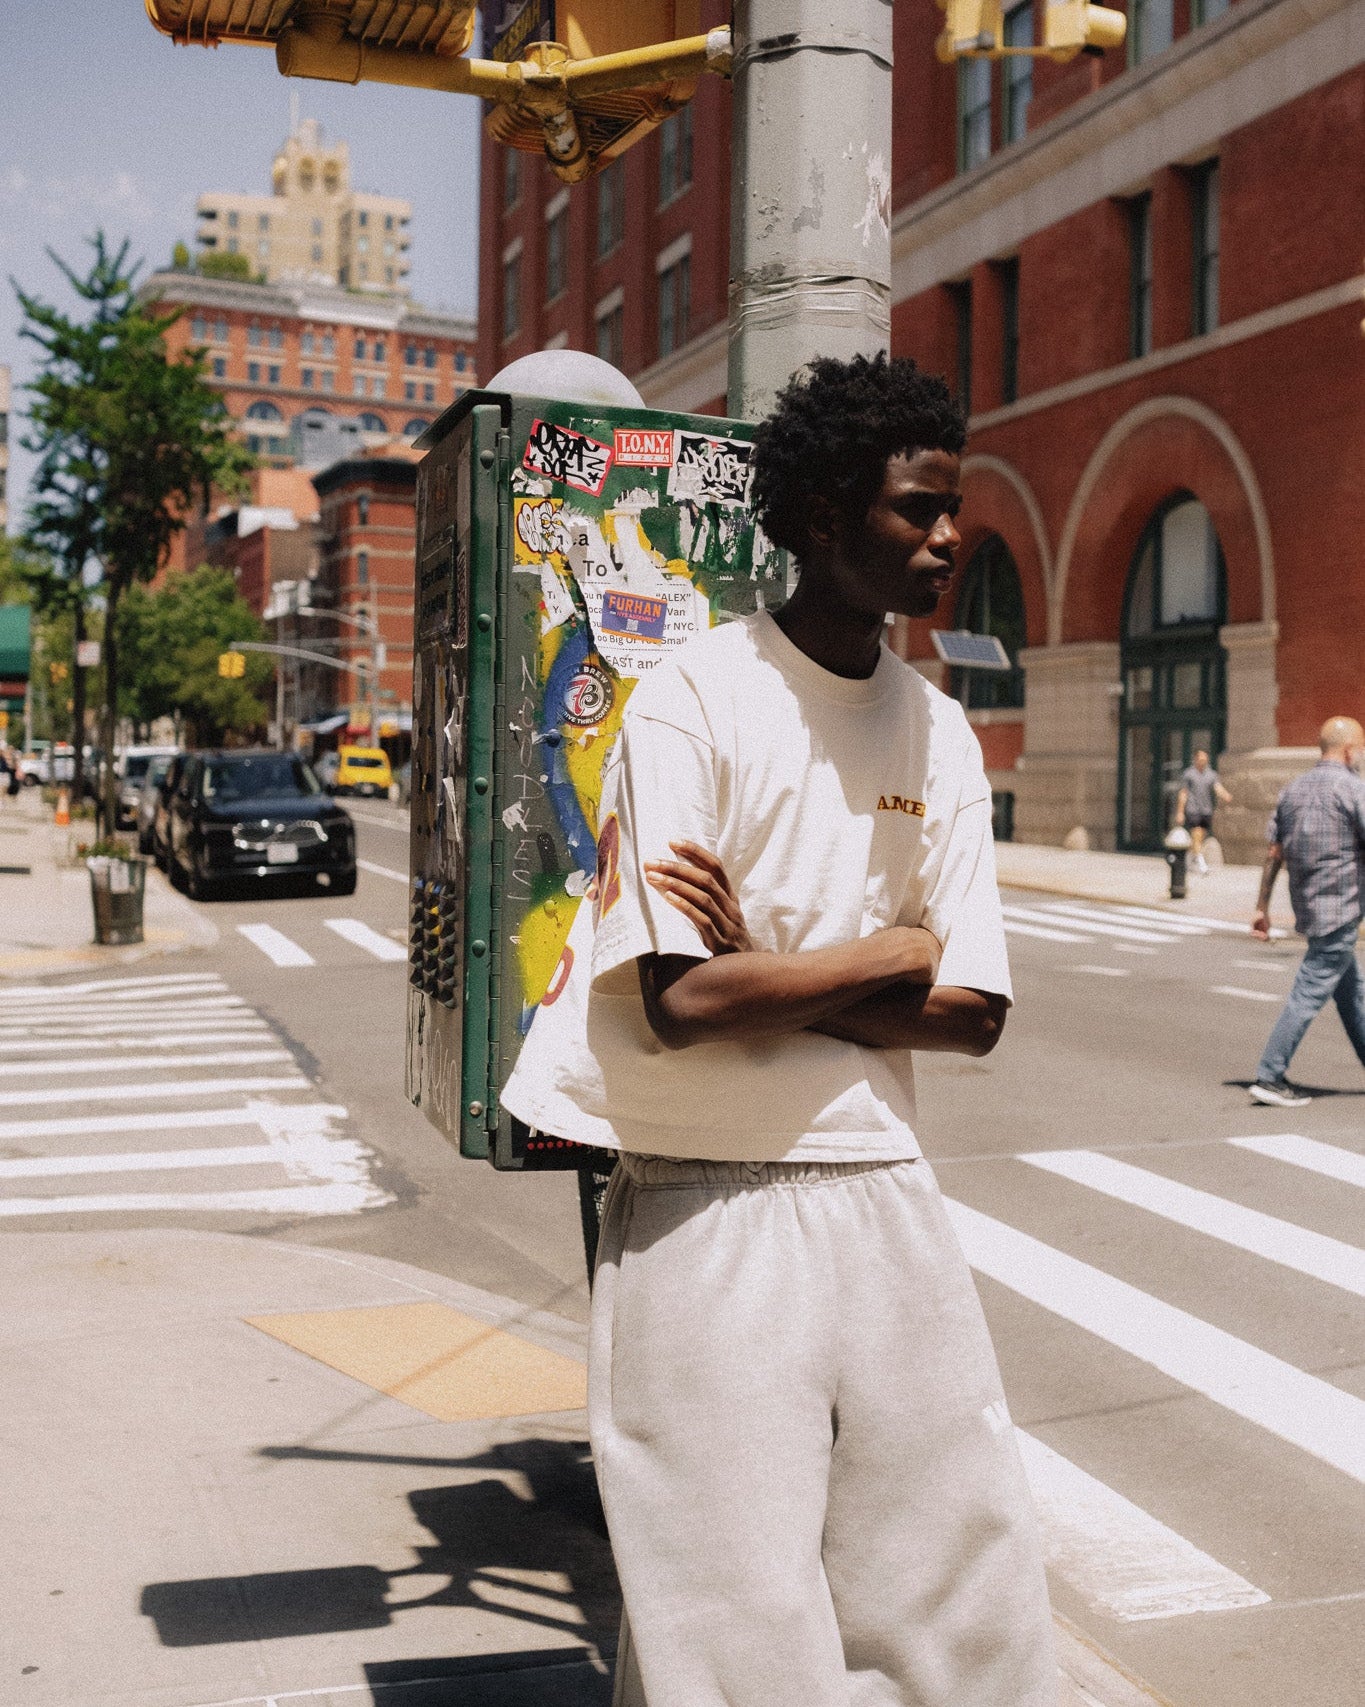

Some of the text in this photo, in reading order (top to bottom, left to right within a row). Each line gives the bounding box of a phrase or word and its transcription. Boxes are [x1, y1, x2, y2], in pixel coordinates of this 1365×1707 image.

[618, 433, 669, 453] T.O.N.Y.
[608, 596, 662, 618] FURHAN
[667, 608, 686, 616] Van
[609, 635, 624, 645] Big
[583, 666, 609, 684] BREW
[576, 717, 594, 725] THRU
[594, 699, 612, 720] COFFEE
